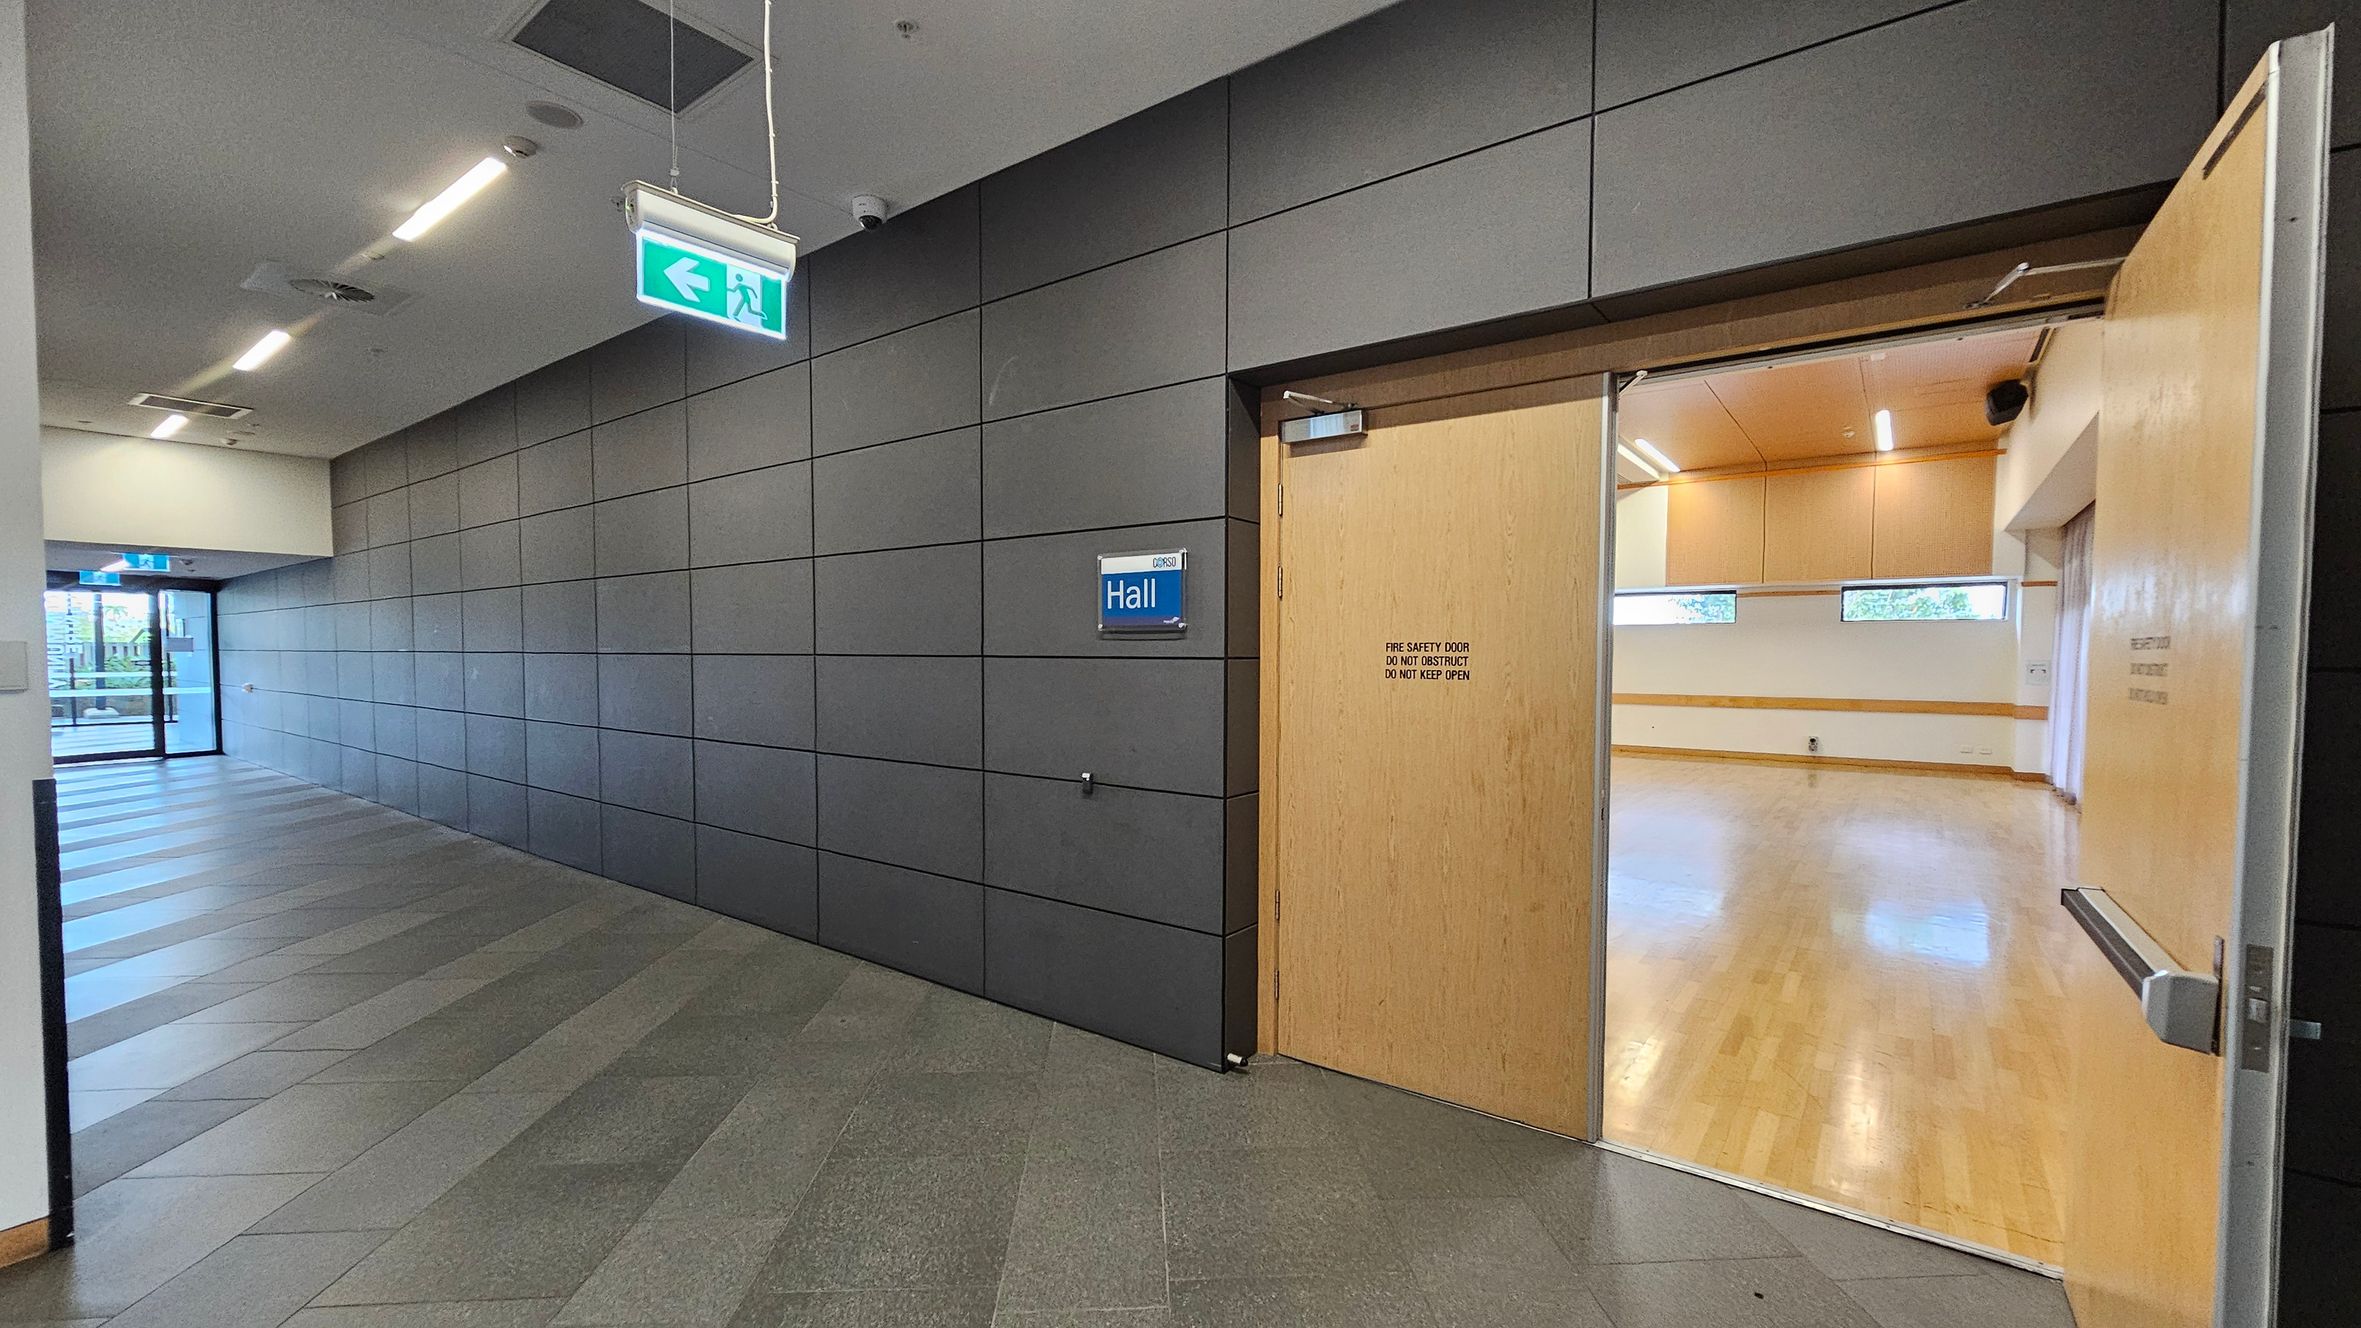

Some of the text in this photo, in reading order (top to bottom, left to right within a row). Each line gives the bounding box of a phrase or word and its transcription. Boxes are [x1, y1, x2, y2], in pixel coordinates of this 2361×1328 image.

[1153, 556, 1176, 568] CORSO
[1107, 578, 1156, 609] Hall
[1385, 642, 1469, 652] FIRE SAFETY DOOR
[1386, 655, 1469, 666] DO NOT OBSTRUCT
[1385, 668, 1470, 680] DO NOT KEEP OPEN
